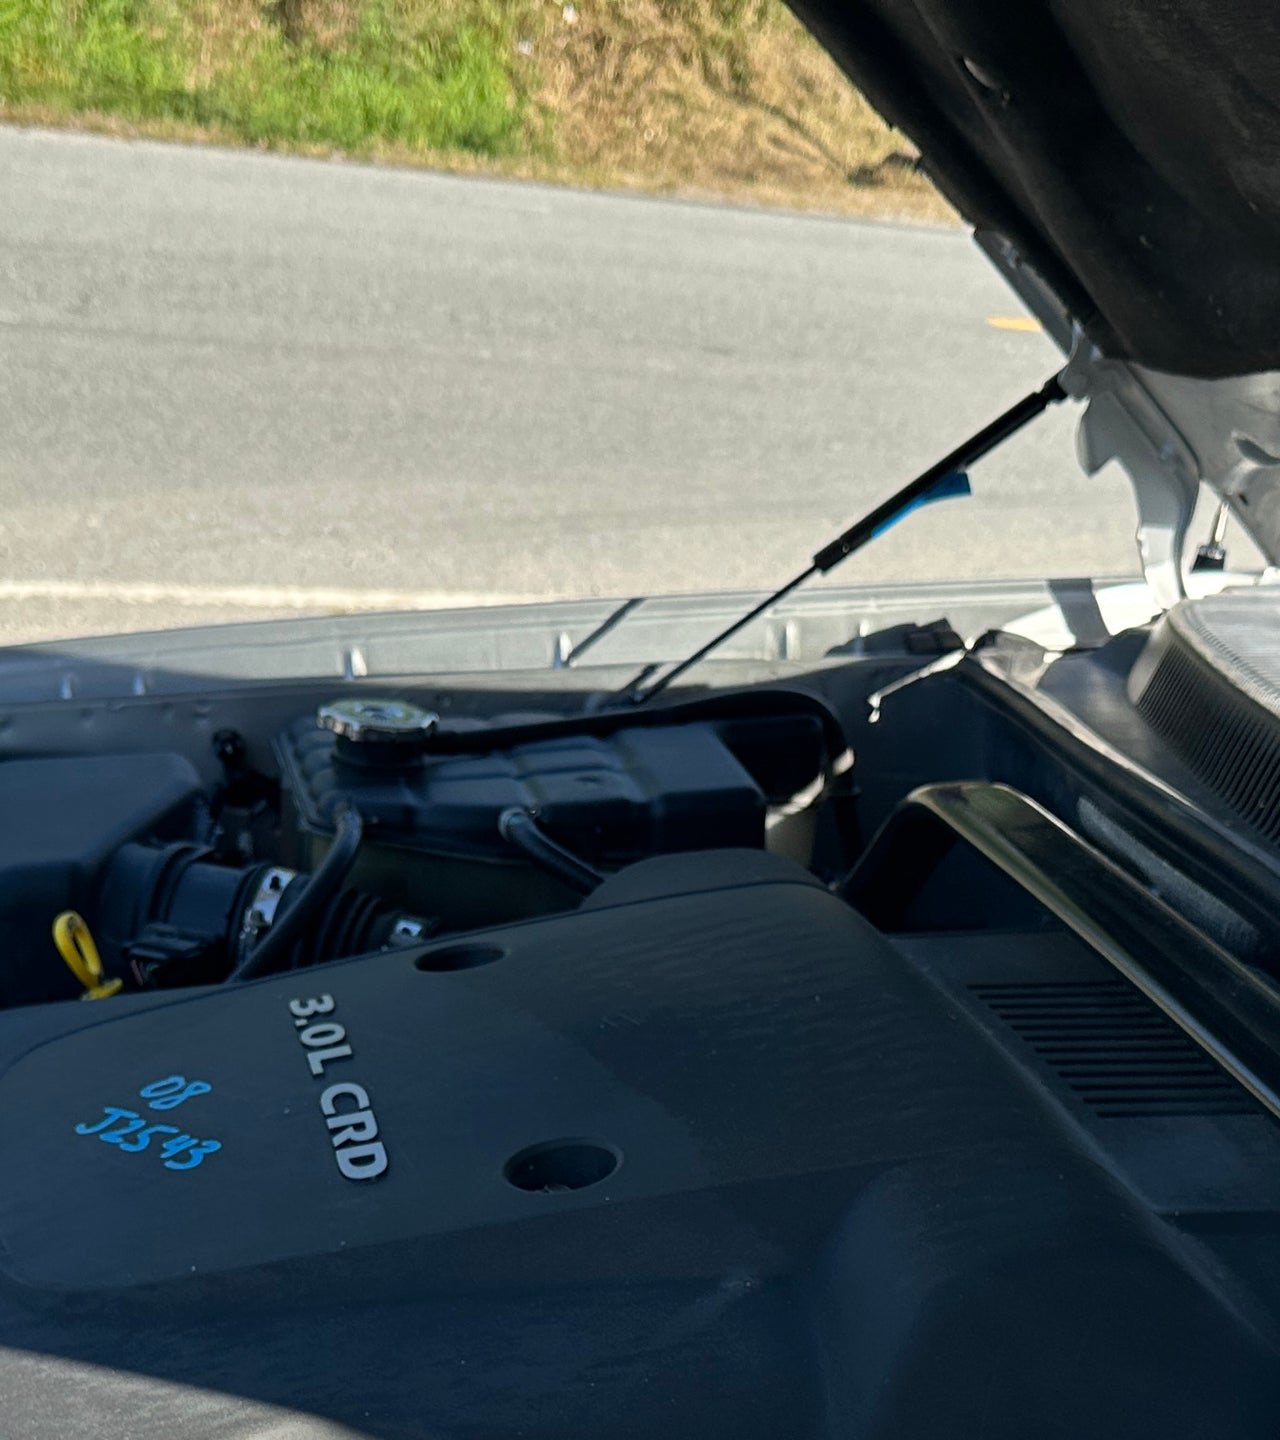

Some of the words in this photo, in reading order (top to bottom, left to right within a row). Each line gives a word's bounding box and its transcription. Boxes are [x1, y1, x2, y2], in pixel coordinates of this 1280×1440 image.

[289, 994, 354, 1077] 3.0L
[140, 1074, 212, 1111] 08
[319, 1081, 388, 1181] CRD
